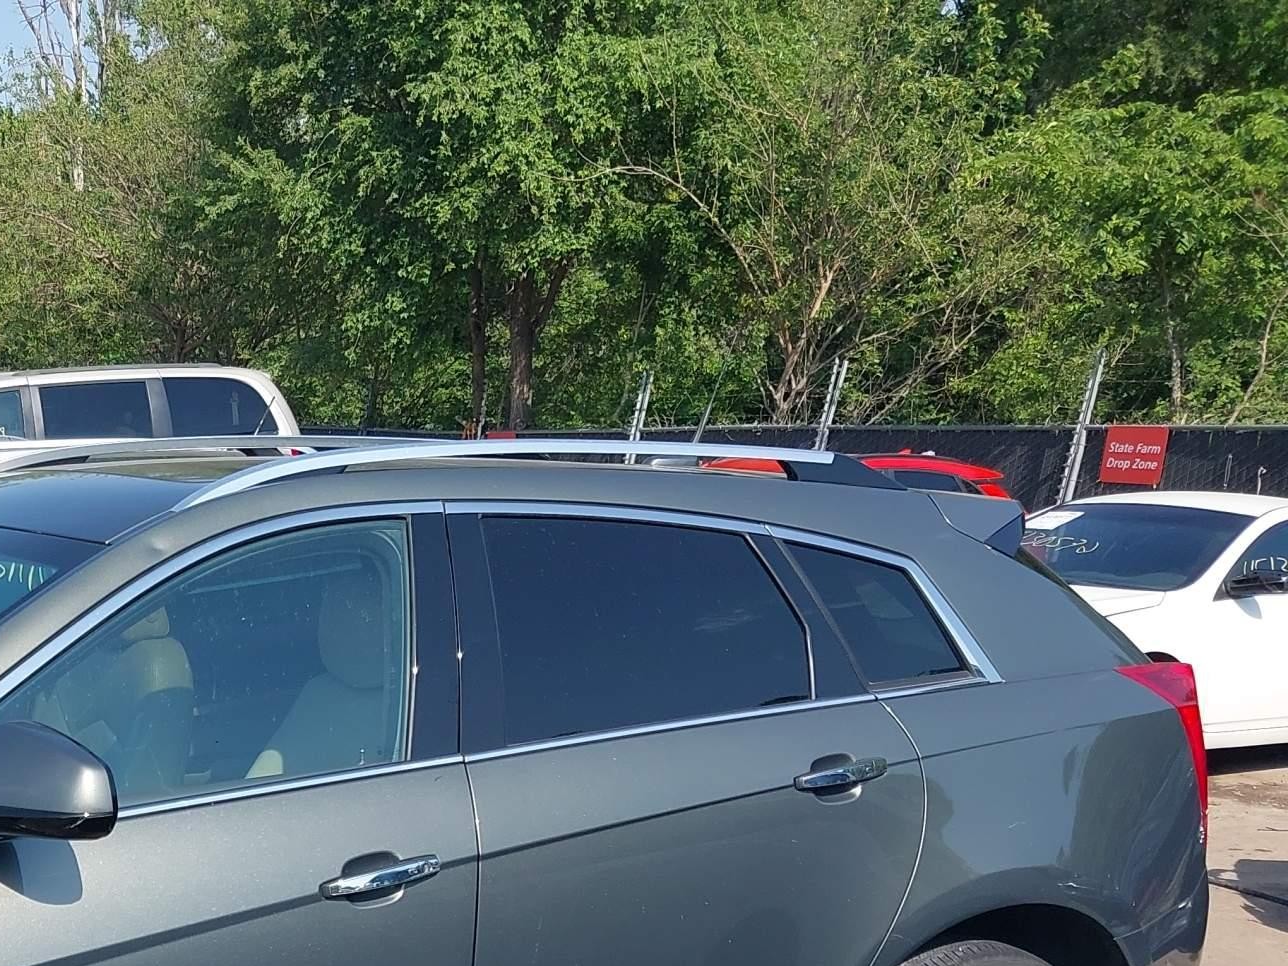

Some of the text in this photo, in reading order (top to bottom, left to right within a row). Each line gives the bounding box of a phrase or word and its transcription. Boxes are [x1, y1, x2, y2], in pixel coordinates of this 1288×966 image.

[1108, 442, 1161, 455] State Farm
[1106, 457, 1158, 471] Drop Zone
